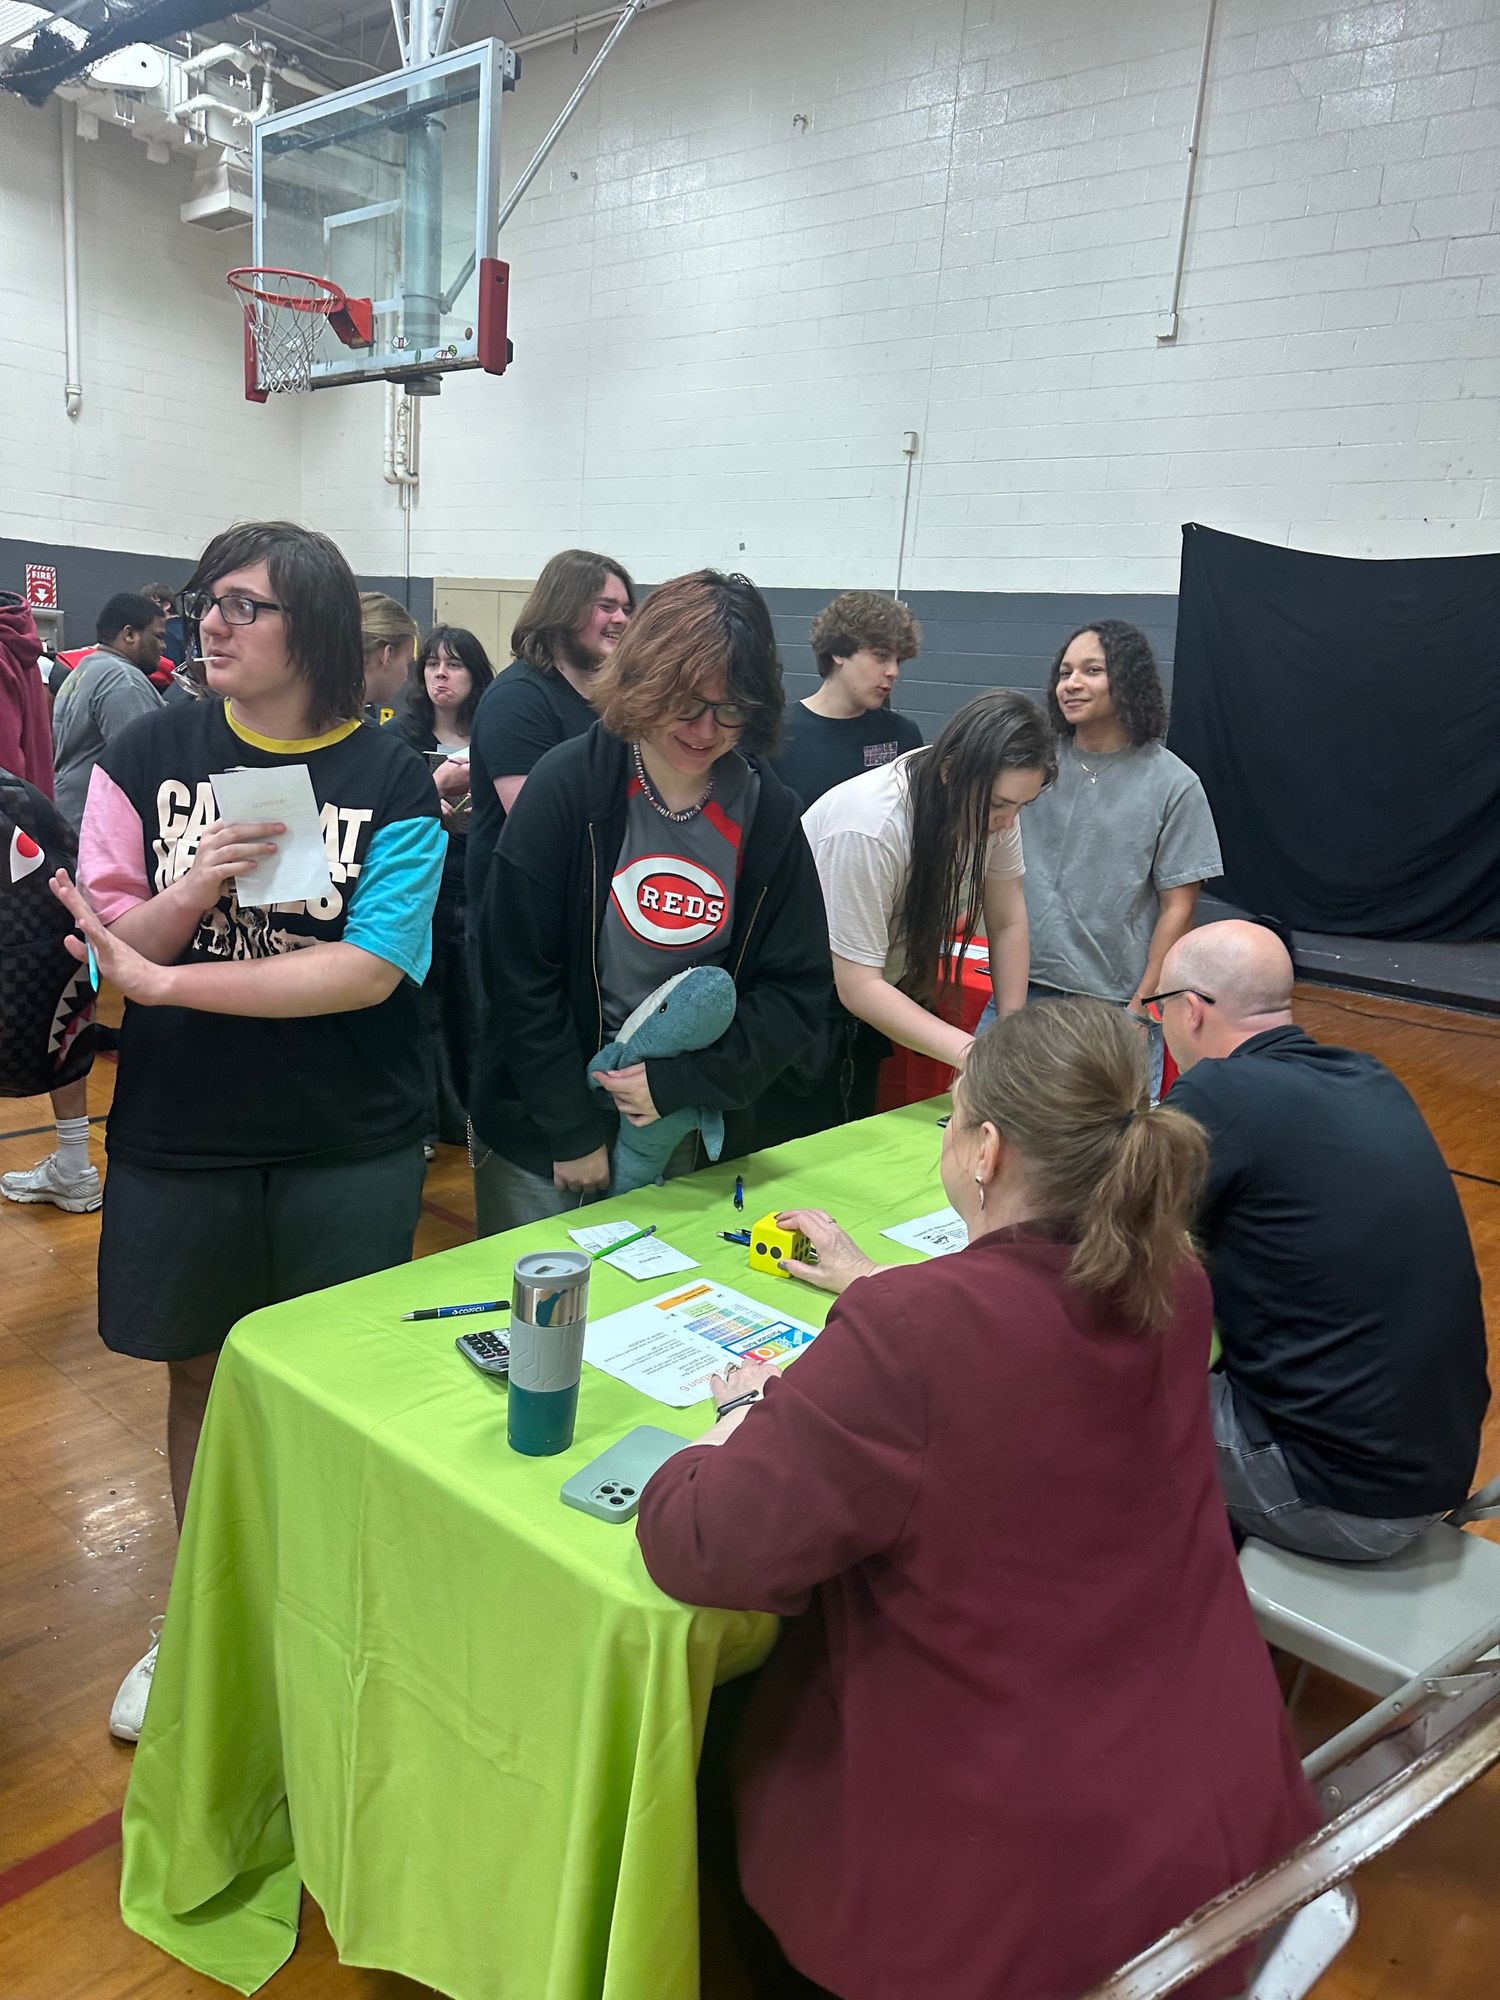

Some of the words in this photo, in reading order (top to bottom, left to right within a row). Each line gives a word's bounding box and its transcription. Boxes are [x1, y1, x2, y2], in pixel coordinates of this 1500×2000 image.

[31, 570, 52, 580] FIRE
[319, 801, 374, 864] AT
[640, 884, 725, 923] REDS
